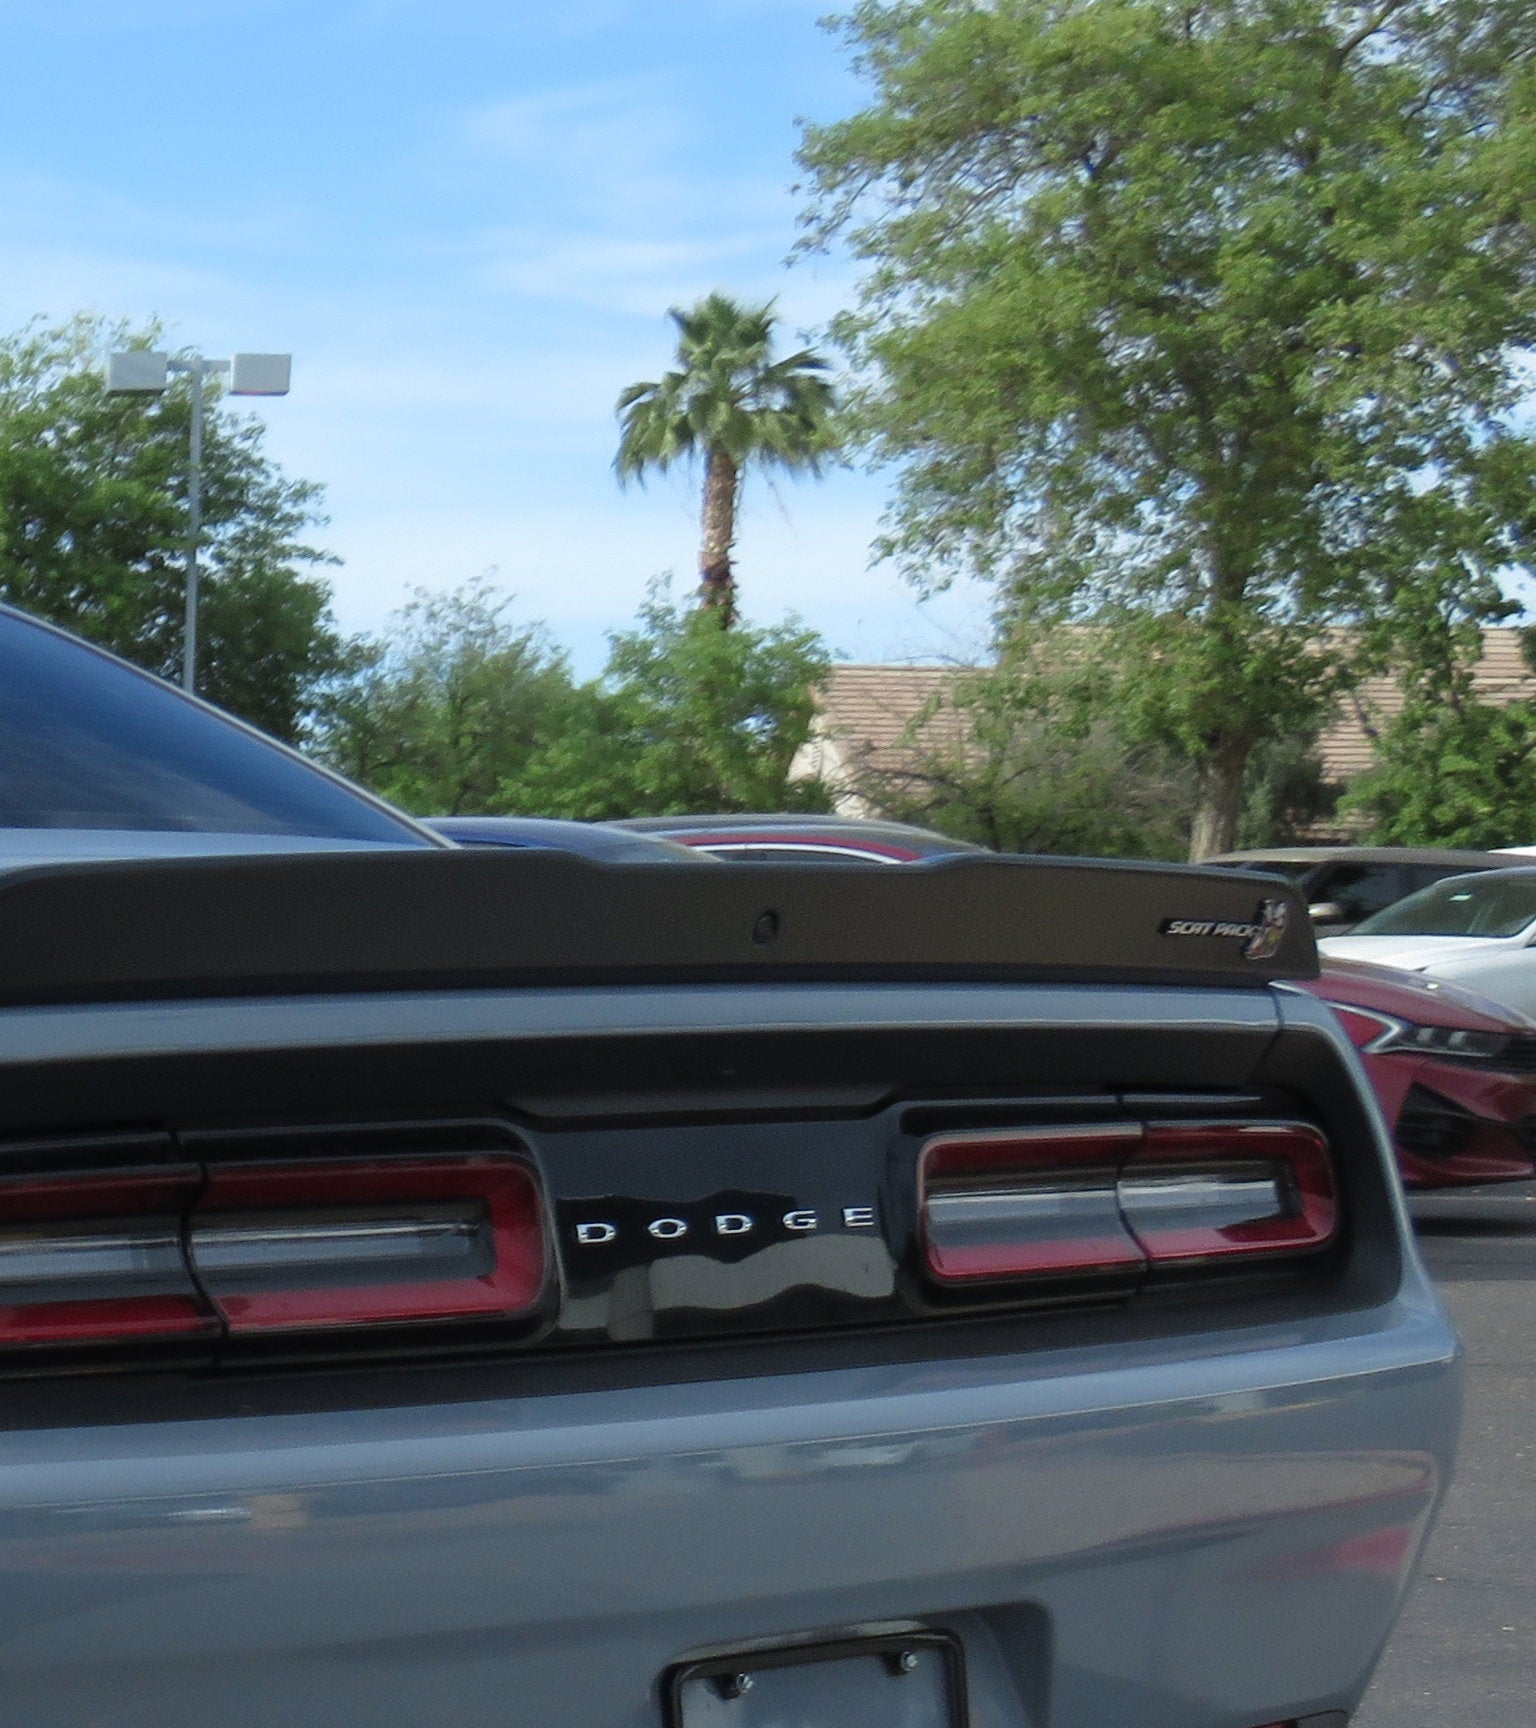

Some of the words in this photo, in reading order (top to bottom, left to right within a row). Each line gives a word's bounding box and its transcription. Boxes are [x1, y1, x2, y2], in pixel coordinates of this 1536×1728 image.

[1166, 920, 1215, 935] SCAT
[1212, 922, 1262, 938] PACK
[576, 1207, 875, 1245] DODGE
